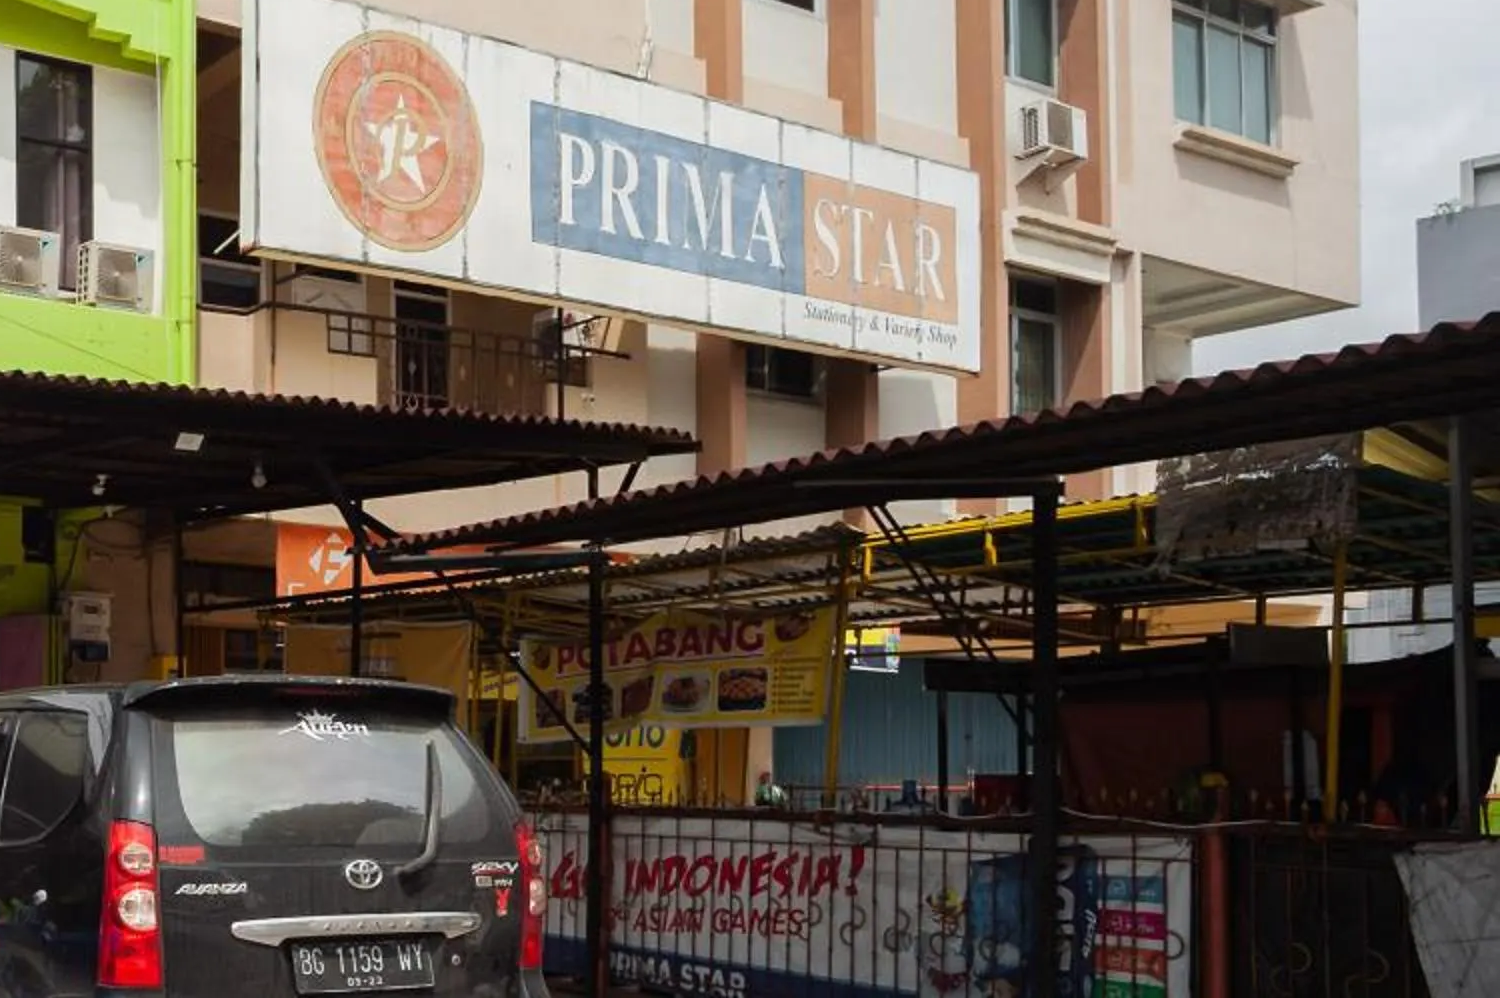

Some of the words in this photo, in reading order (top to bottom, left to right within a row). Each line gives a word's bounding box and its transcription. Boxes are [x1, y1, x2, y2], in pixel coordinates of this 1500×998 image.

[558, 132, 786, 270] PRIMA
[813, 200, 945, 300] STAR
[927, 328, 957, 350] Shop
[625, 845, 865, 898] INDONESIA!
[633, 908, 704, 934] ASIAN
[711, 907, 806, 937] GAMES
[300, 947, 325, 975] BG
[336, 944, 384, 974] 1159
[397, 943, 423, 971] WY
